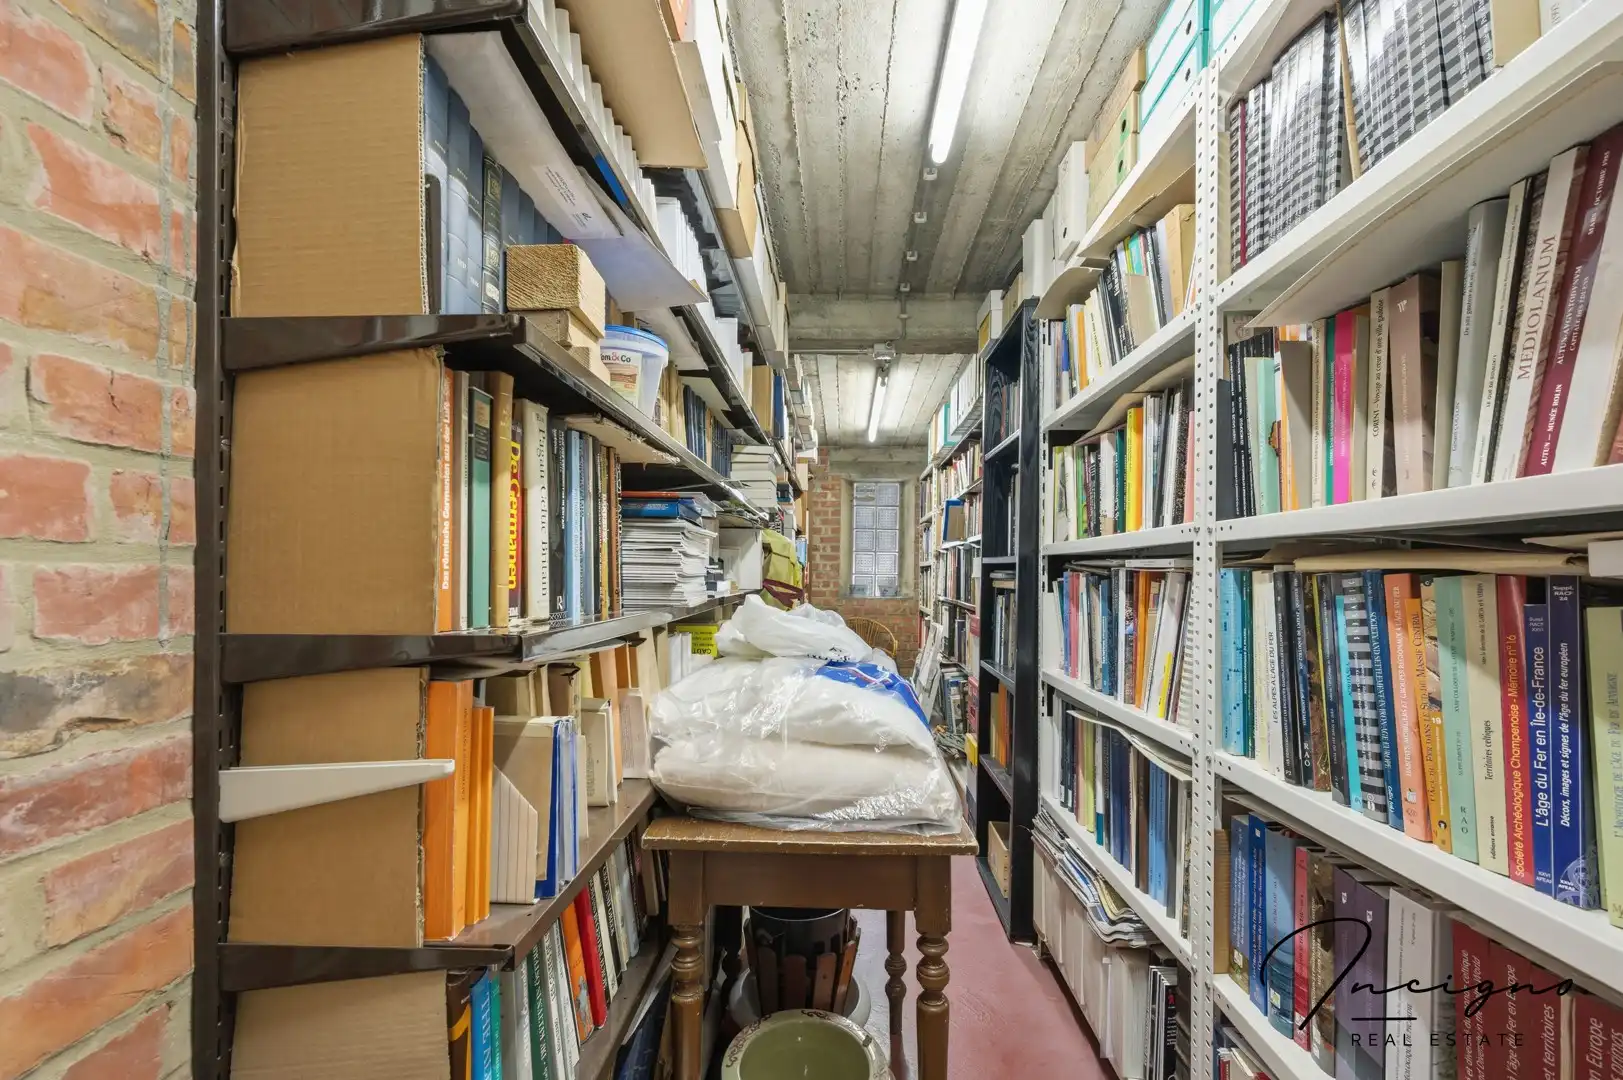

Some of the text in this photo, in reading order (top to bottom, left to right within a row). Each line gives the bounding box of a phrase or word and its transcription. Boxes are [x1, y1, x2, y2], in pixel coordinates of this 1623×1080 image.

[1593, 167, 1608, 206] OCTOBRE
[1517, 234, 1557, 381] MEDIOLANUM
[1569, 318, 1582, 351] CAPITALE
[1576, 304, 1585, 317] DES
[620, 354, 632, 364] Co
[443, 424, 451, 444] der
[1372, 409, 1381, 437] CORENT
[1540, 383, 1564, 467] AUTUN MUSÉE ROLIN
[443, 445, 451, 462] aus
[537, 428, 548, 479] Pagan
[441, 462, 451, 519] Germanien
[508, 440, 521, 590] De Germanen
[540, 486, 549, 534] Celtic
[441, 522, 451, 569] römische
[441, 570, 450, 590] Das
[541, 541, 549, 597] Britain
[1266, 631, 1275, 647] FER
[1369, 611, 1380, 640] SOCIETY
[1410, 612, 1423, 647] CENTRAL
[1266, 646, 1275, 658] DU
[1372, 640, 1382, 655] AND
[1373, 654, 1386, 699] SETTLEMENT
[1413, 649, 1427, 678] MASSIF
[1506, 657, 1521, 698] Mémoire
[1269, 685, 1279, 710] ALPES
[1528, 646, 1547, 727] Île-de-France
[1378, 699, 1388, 708] IN
[1419, 694, 1430, 711] SUD
[1270, 710, 1279, 724] LES
[1378, 707, 1389, 728] IRON
[1431, 716, 1442, 726] 19
[1607, 721, 1621, 735] FER
[1381, 728, 1391, 742] AGE
[1422, 724, 1433, 745] DANS
[1506, 705, 1524, 769] Champenoise
[1535, 730, 1547, 746] en
[1557, 642, 1573, 828] Décors, images et signes de l'âge du fer européen
[1303, 742, 1312, 768] RAO
[1382, 741, 1393, 769] EUROPE
[1424, 746, 1435, 763] FER
[1480, 720, 1495, 781] Territoires celtiques
[1532, 747, 1547, 771] Fer
[1534, 773, 1548, 790] du
[1459, 806, 1469, 834] RAO
[1510, 770, 1525, 842] Archéologique
[1535, 792, 1552, 828] L'âge
[1488, 814, 1498, 860] éditions errance
[1513, 841, 1526, 878] Société
[1460, 950, 1473, 984] celtique
[1470, 957, 1482, 982] World
[1463, 1018, 1472, 1030] du
[1474, 1011, 1484, 1025] the
[1503, 964, 1521, 1077] l'âge du Fer en Europe
[1540, 1003, 1556, 1080] et territoires
[1585, 1017, 1609, 1069] Europe
[1463, 1068, 1474, 1078] et
